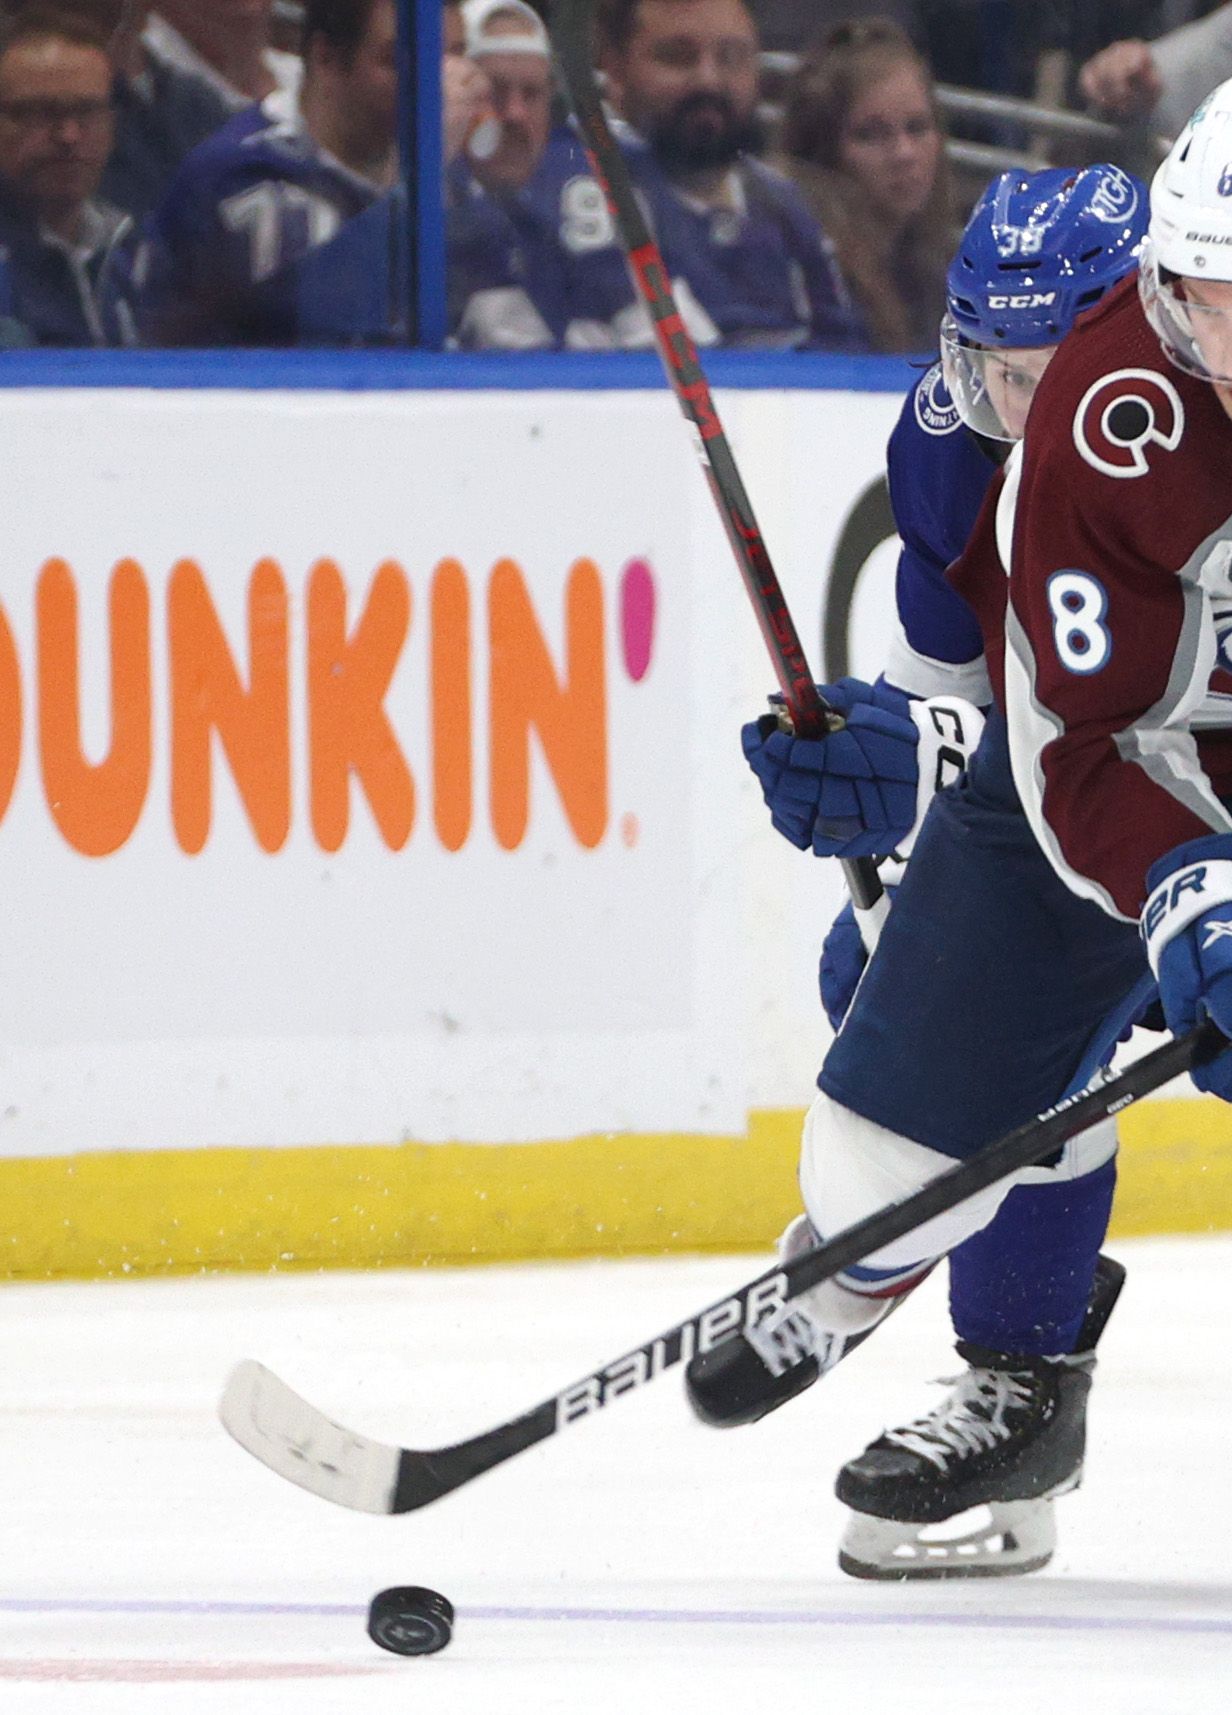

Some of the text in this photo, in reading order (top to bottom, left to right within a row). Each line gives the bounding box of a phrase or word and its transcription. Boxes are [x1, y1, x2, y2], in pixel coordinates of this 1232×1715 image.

[628, 243, 725, 440] CCM
[988, 291, 1056, 309] CCM
[1046, 568, 1112, 676] 8
[0, 556, 656, 858] UNKIN'
[928, 705, 970, 794] CC
